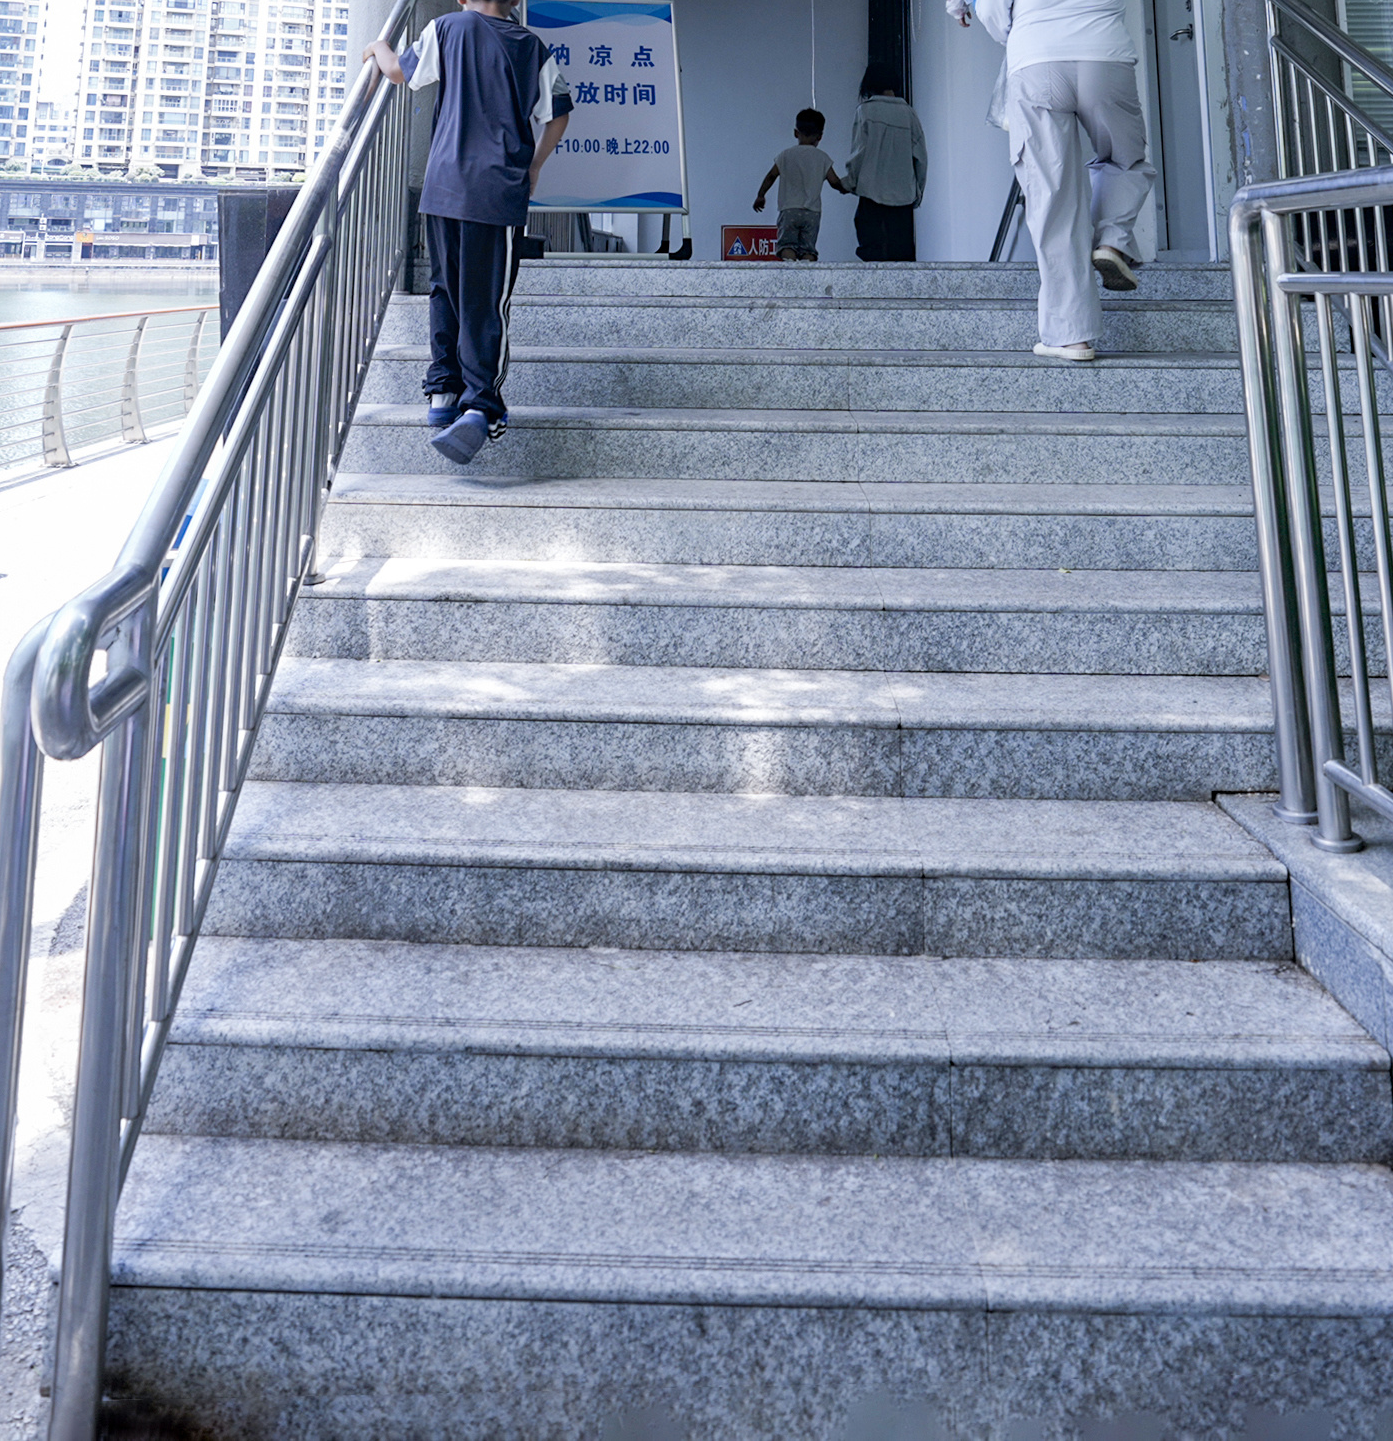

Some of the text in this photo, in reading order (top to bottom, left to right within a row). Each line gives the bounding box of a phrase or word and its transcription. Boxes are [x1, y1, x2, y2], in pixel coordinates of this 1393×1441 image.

[567, 82, 656, 105] 放时间
[748, 238, 778, 256] 人防工
